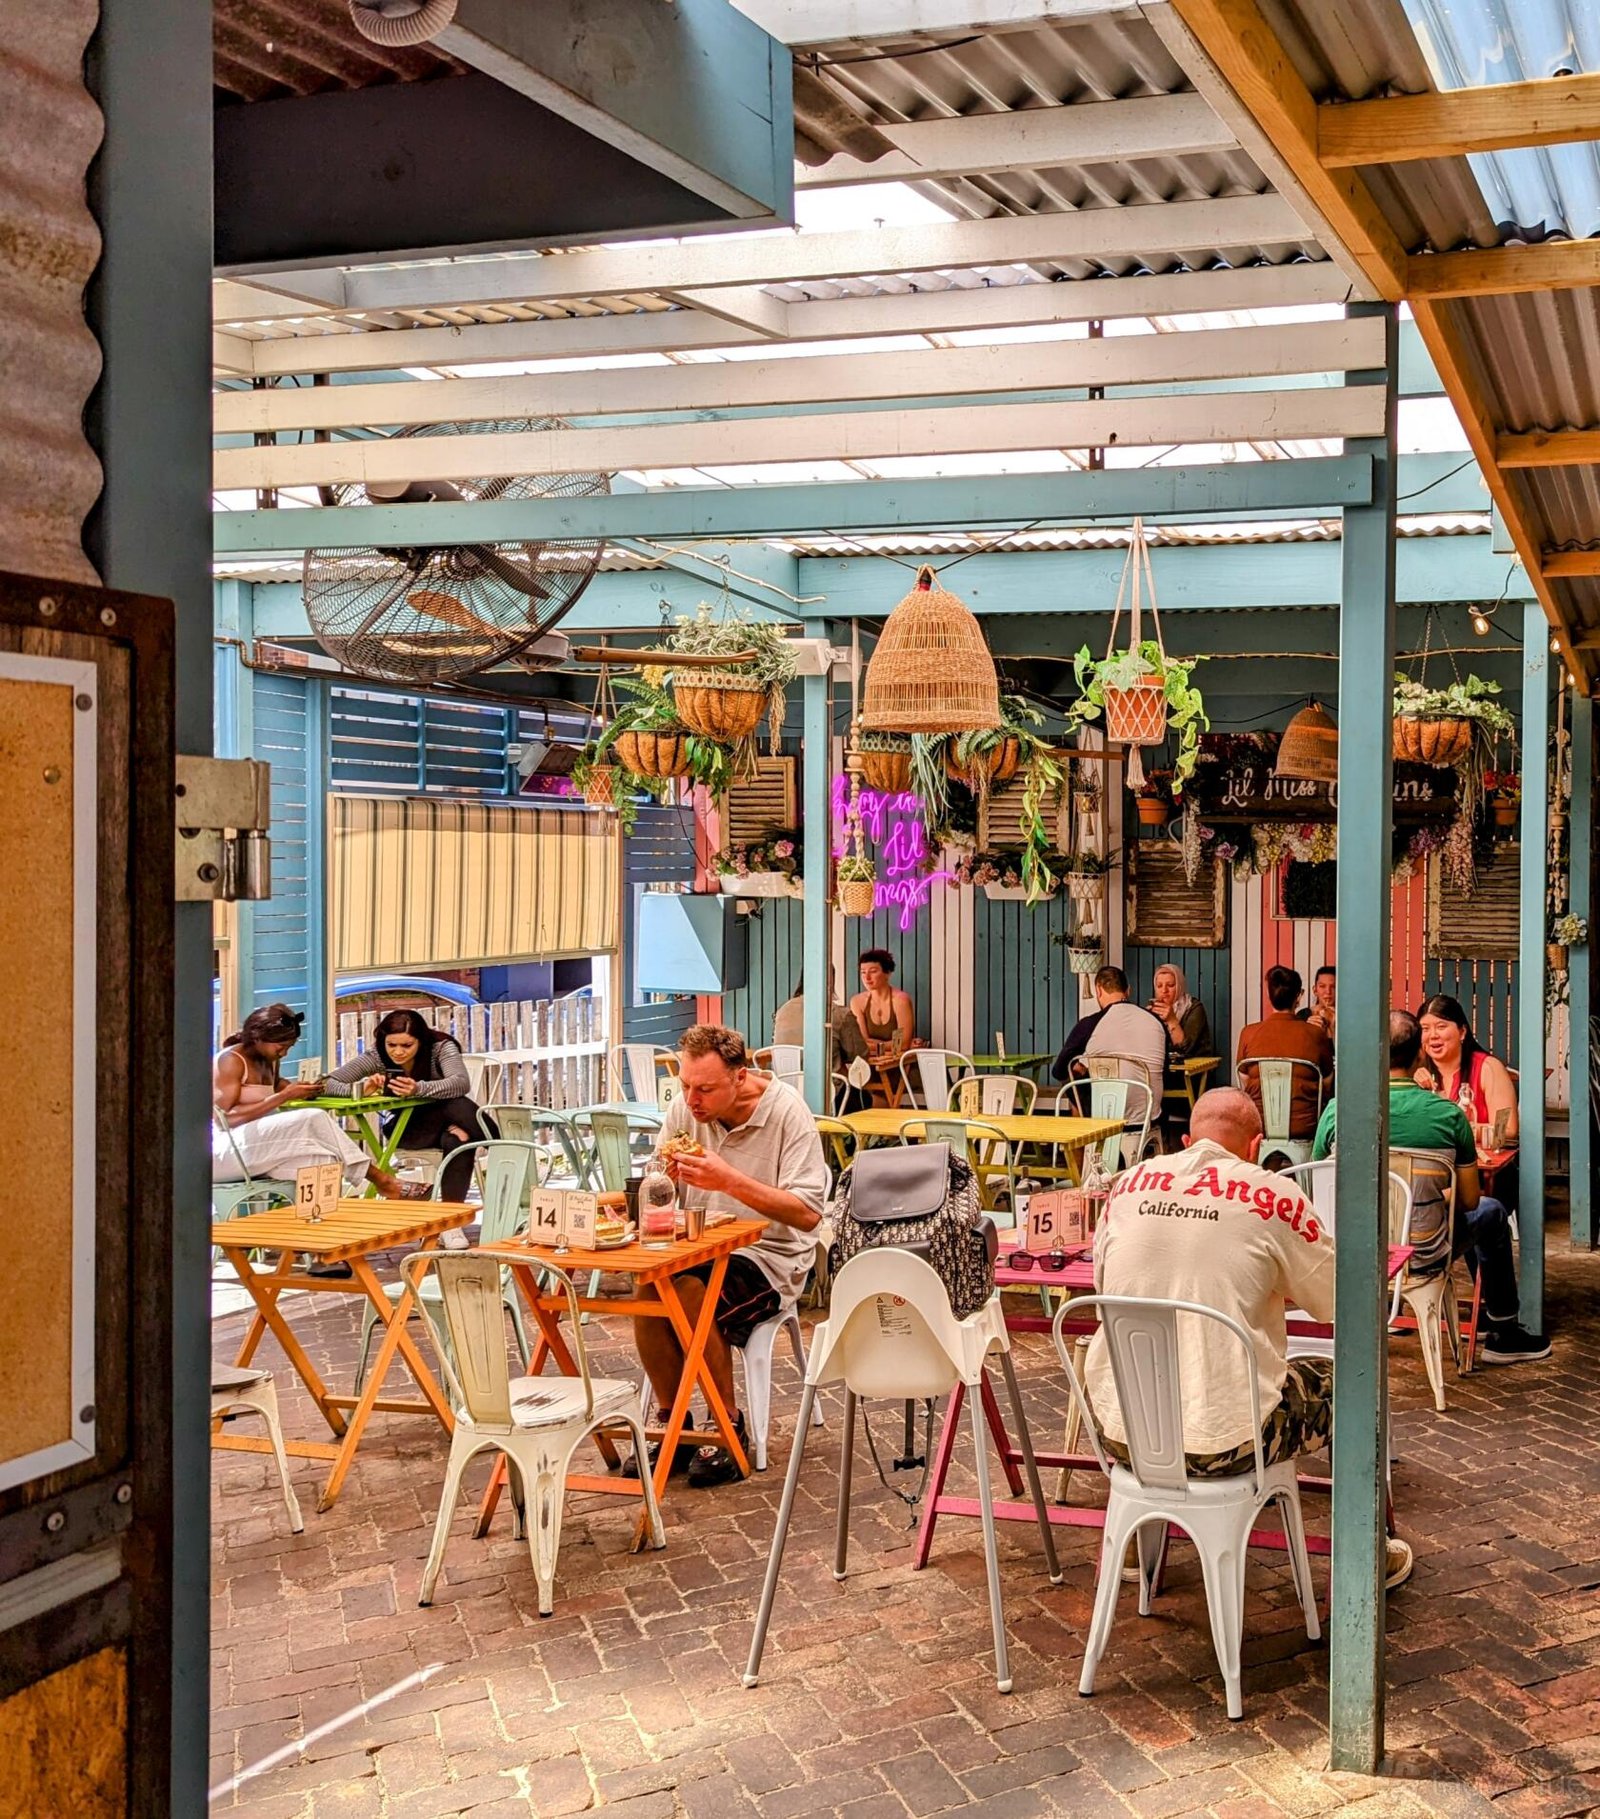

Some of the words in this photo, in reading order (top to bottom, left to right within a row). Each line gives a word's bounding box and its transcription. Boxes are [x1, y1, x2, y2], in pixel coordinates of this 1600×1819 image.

[1221, 767, 1255, 808] Lil
[1264, 767, 1317, 801] Miss
[883, 821, 924, 877] Lil
[664, 1088, 672, 1102] 8
[300, 1183, 314, 1204] 13
[1183, 1166, 1320, 1243] Angels
[536, 1206, 557, 1228] 14
[1138, 1199, 1220, 1222] California
[1033, 1211, 1053, 1235] 15
